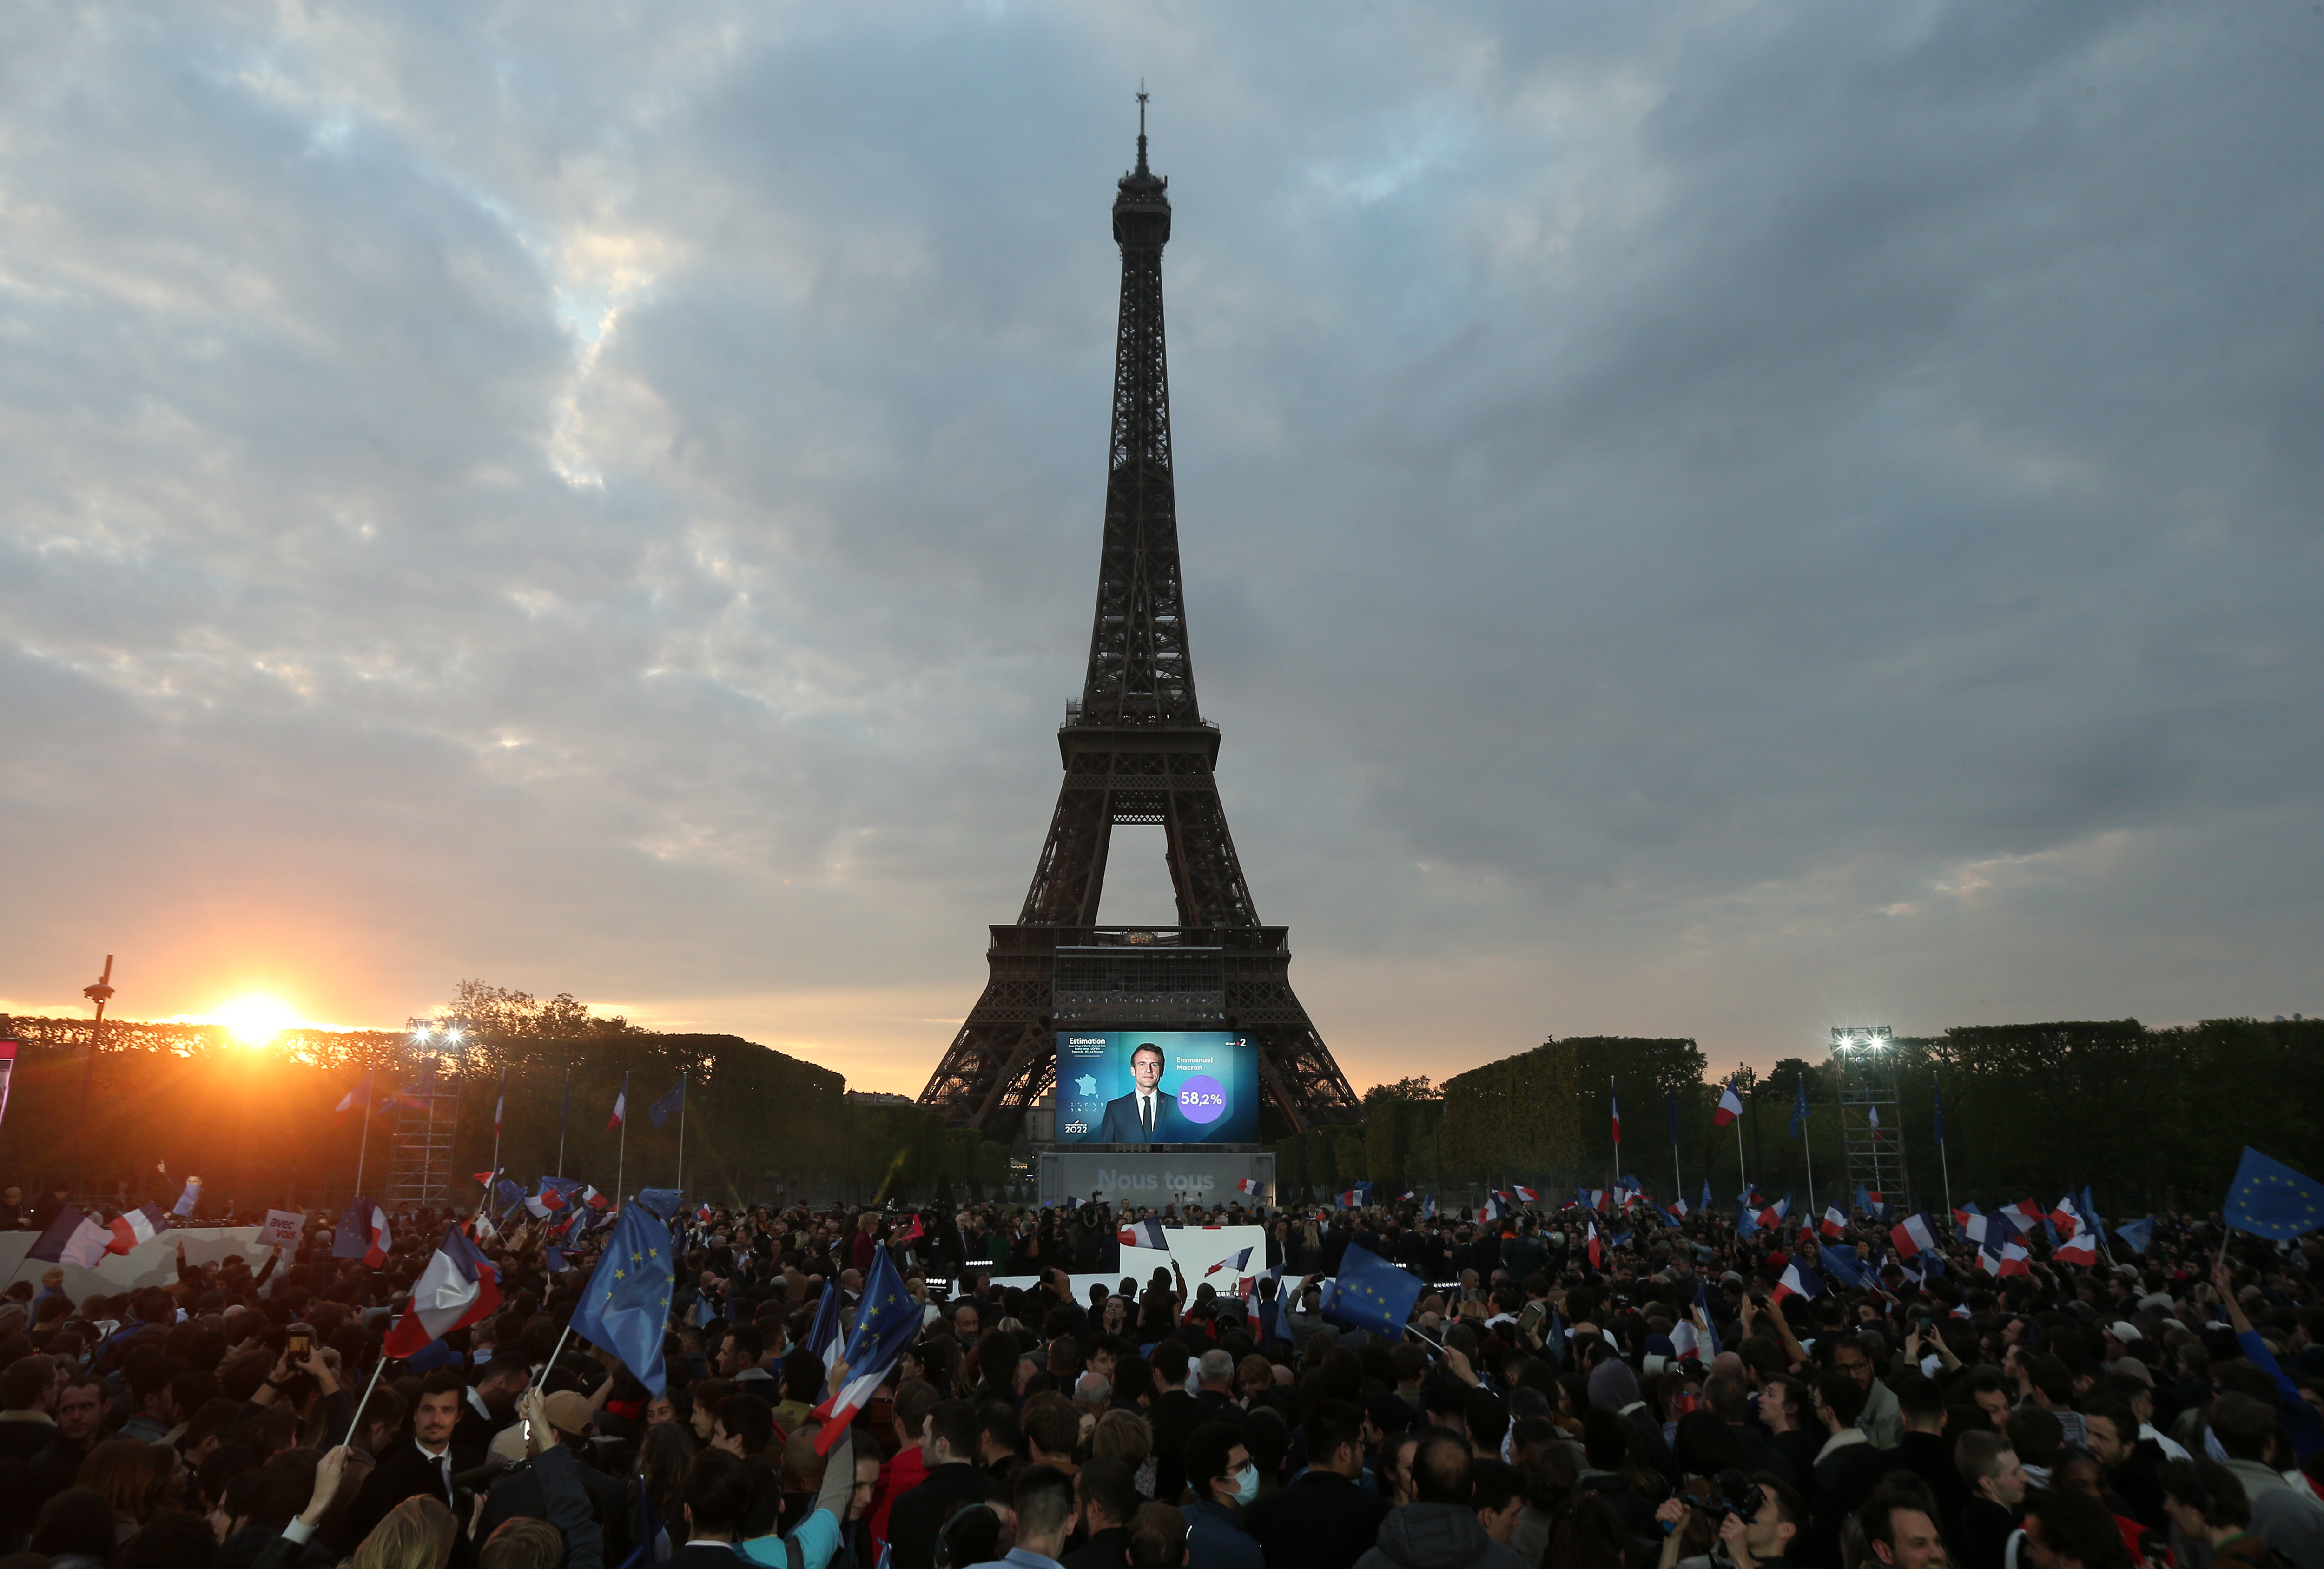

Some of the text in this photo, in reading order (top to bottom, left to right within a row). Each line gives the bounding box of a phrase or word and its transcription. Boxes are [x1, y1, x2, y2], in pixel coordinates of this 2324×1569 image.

[1240, 1038, 1246, 1047] 2
[1181, 1092, 1222, 1106] 58,2%
[1098, 1168, 1215, 1190] Nous tous
[270, 1218, 294, 1230] avec
